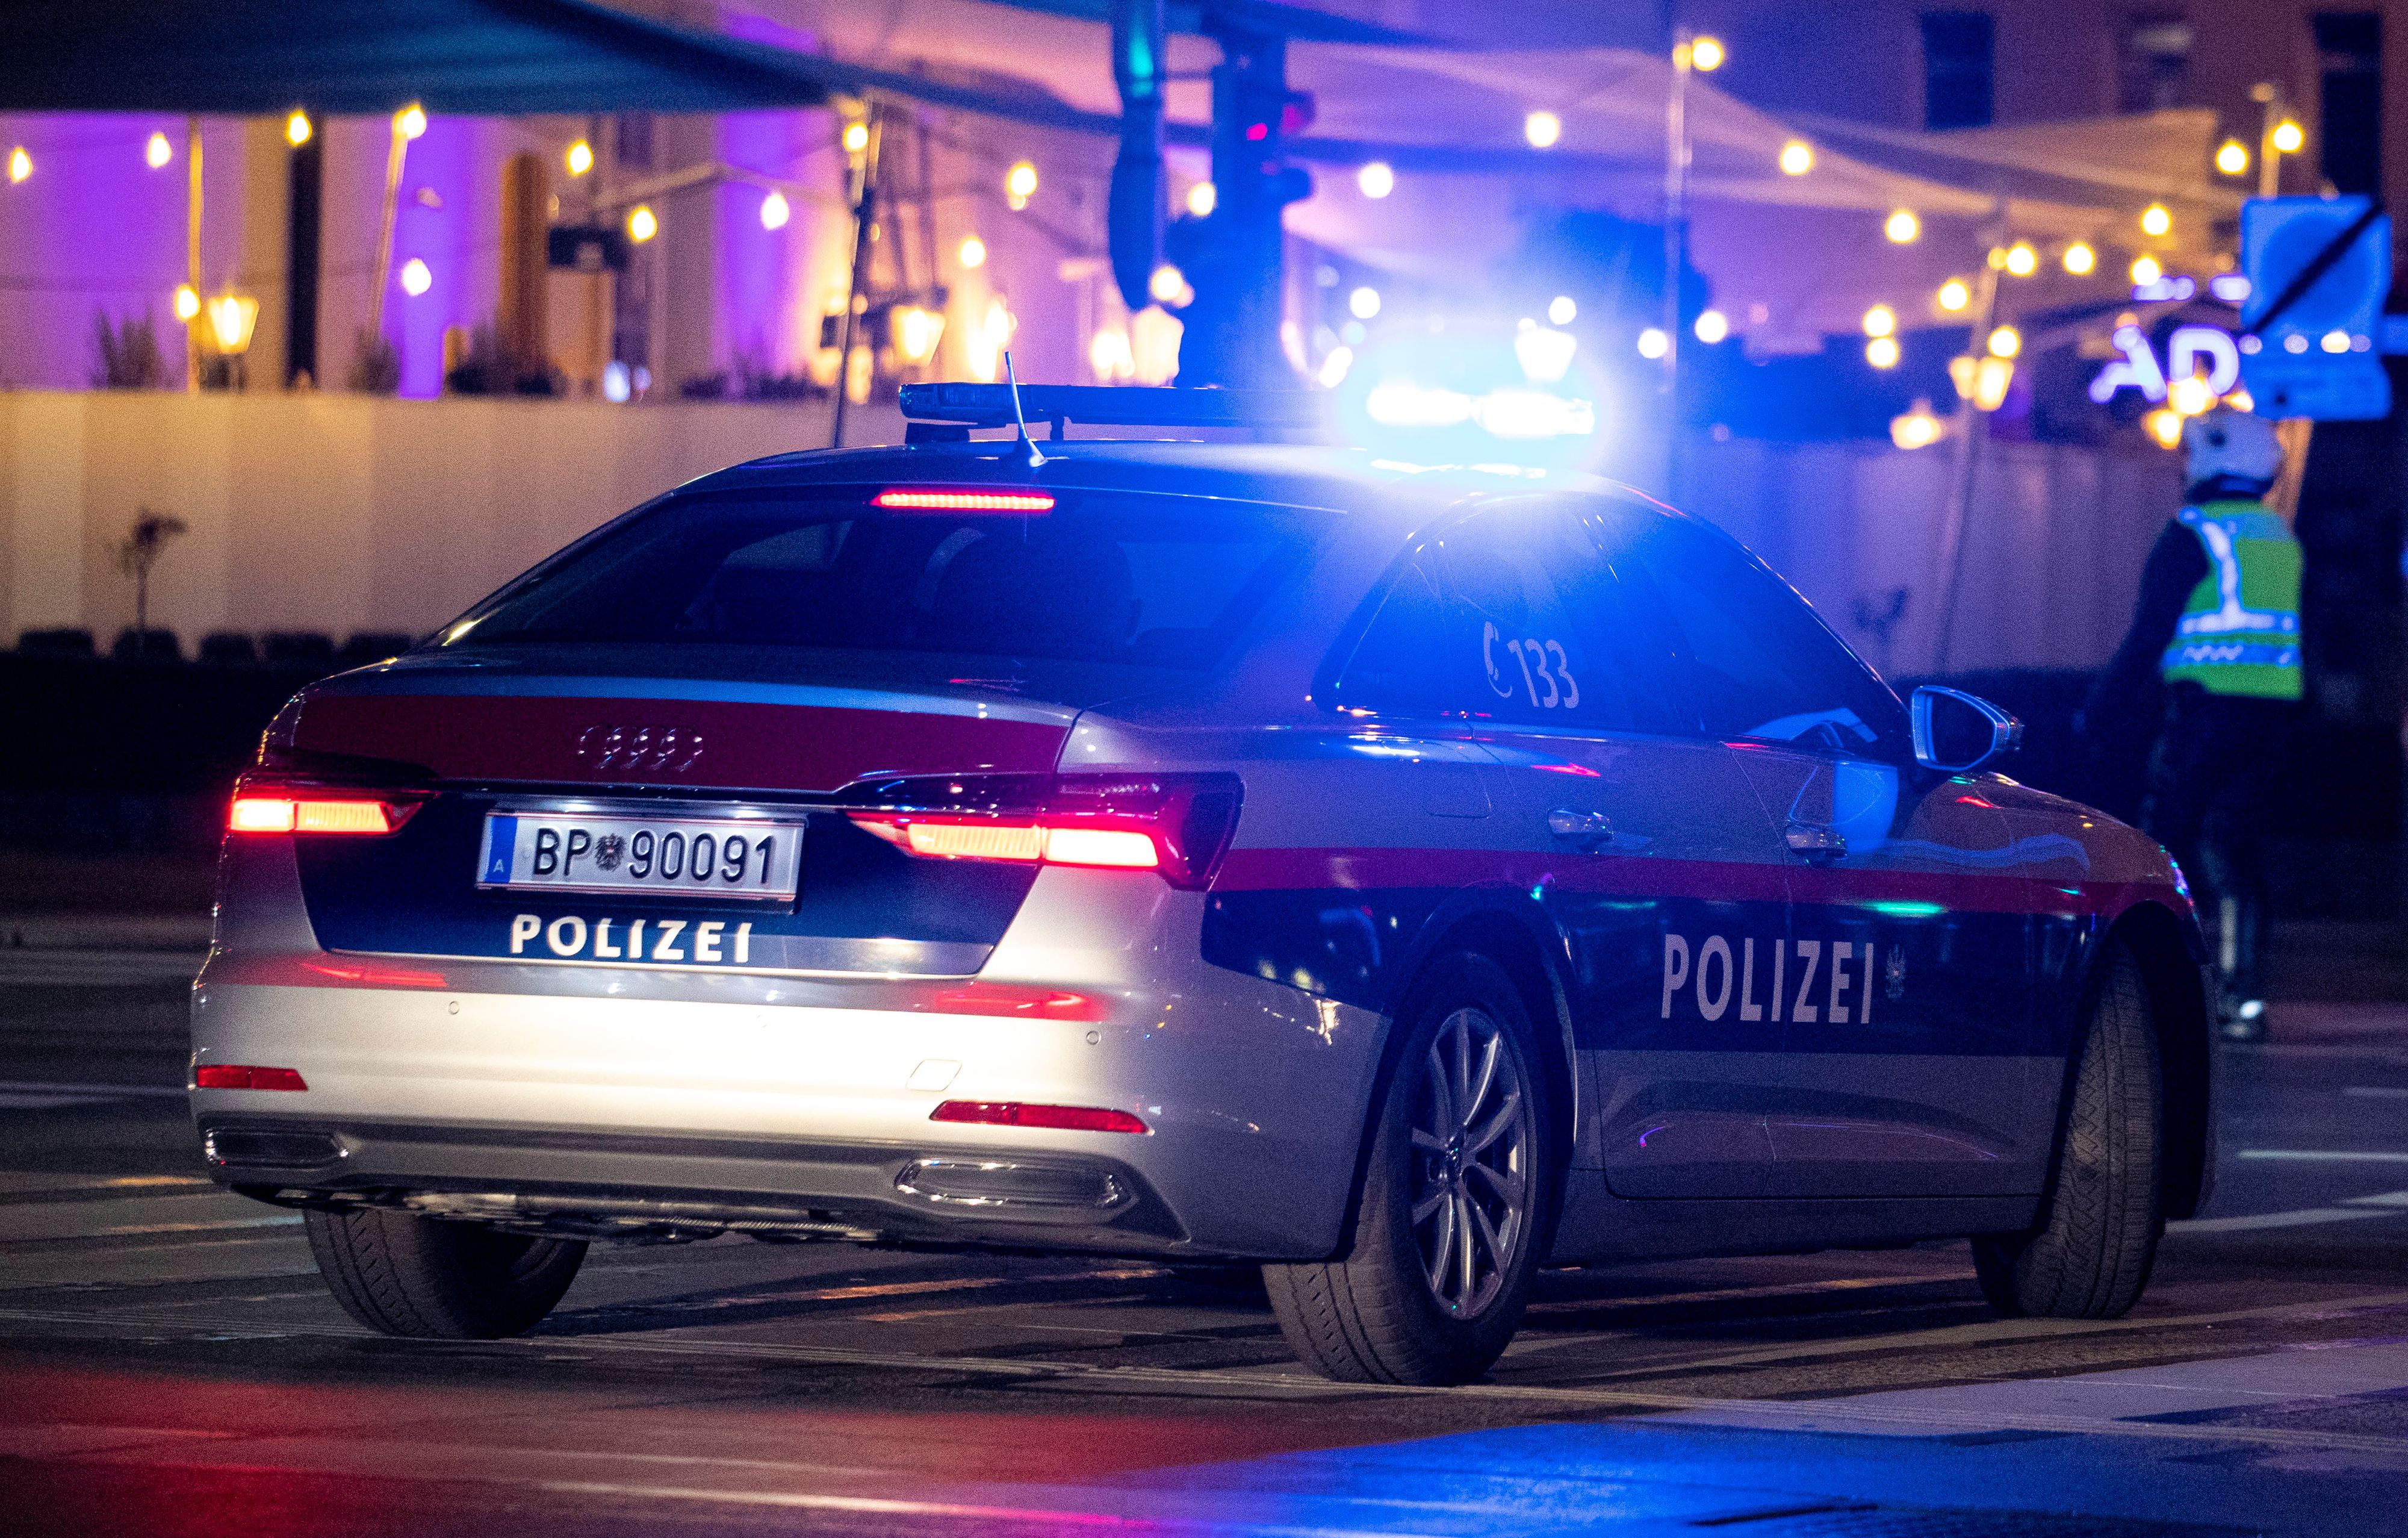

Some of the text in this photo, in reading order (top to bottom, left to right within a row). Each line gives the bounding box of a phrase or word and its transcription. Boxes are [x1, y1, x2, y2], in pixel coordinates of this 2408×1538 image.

[1507, 638, 1579, 708] 133
[493, 859, 504, 873] A
[533, 827, 777, 884] BP 90091
[511, 914, 752, 964] POLIZEI
[1661, 933, 1874, 1024] POLIZEI
